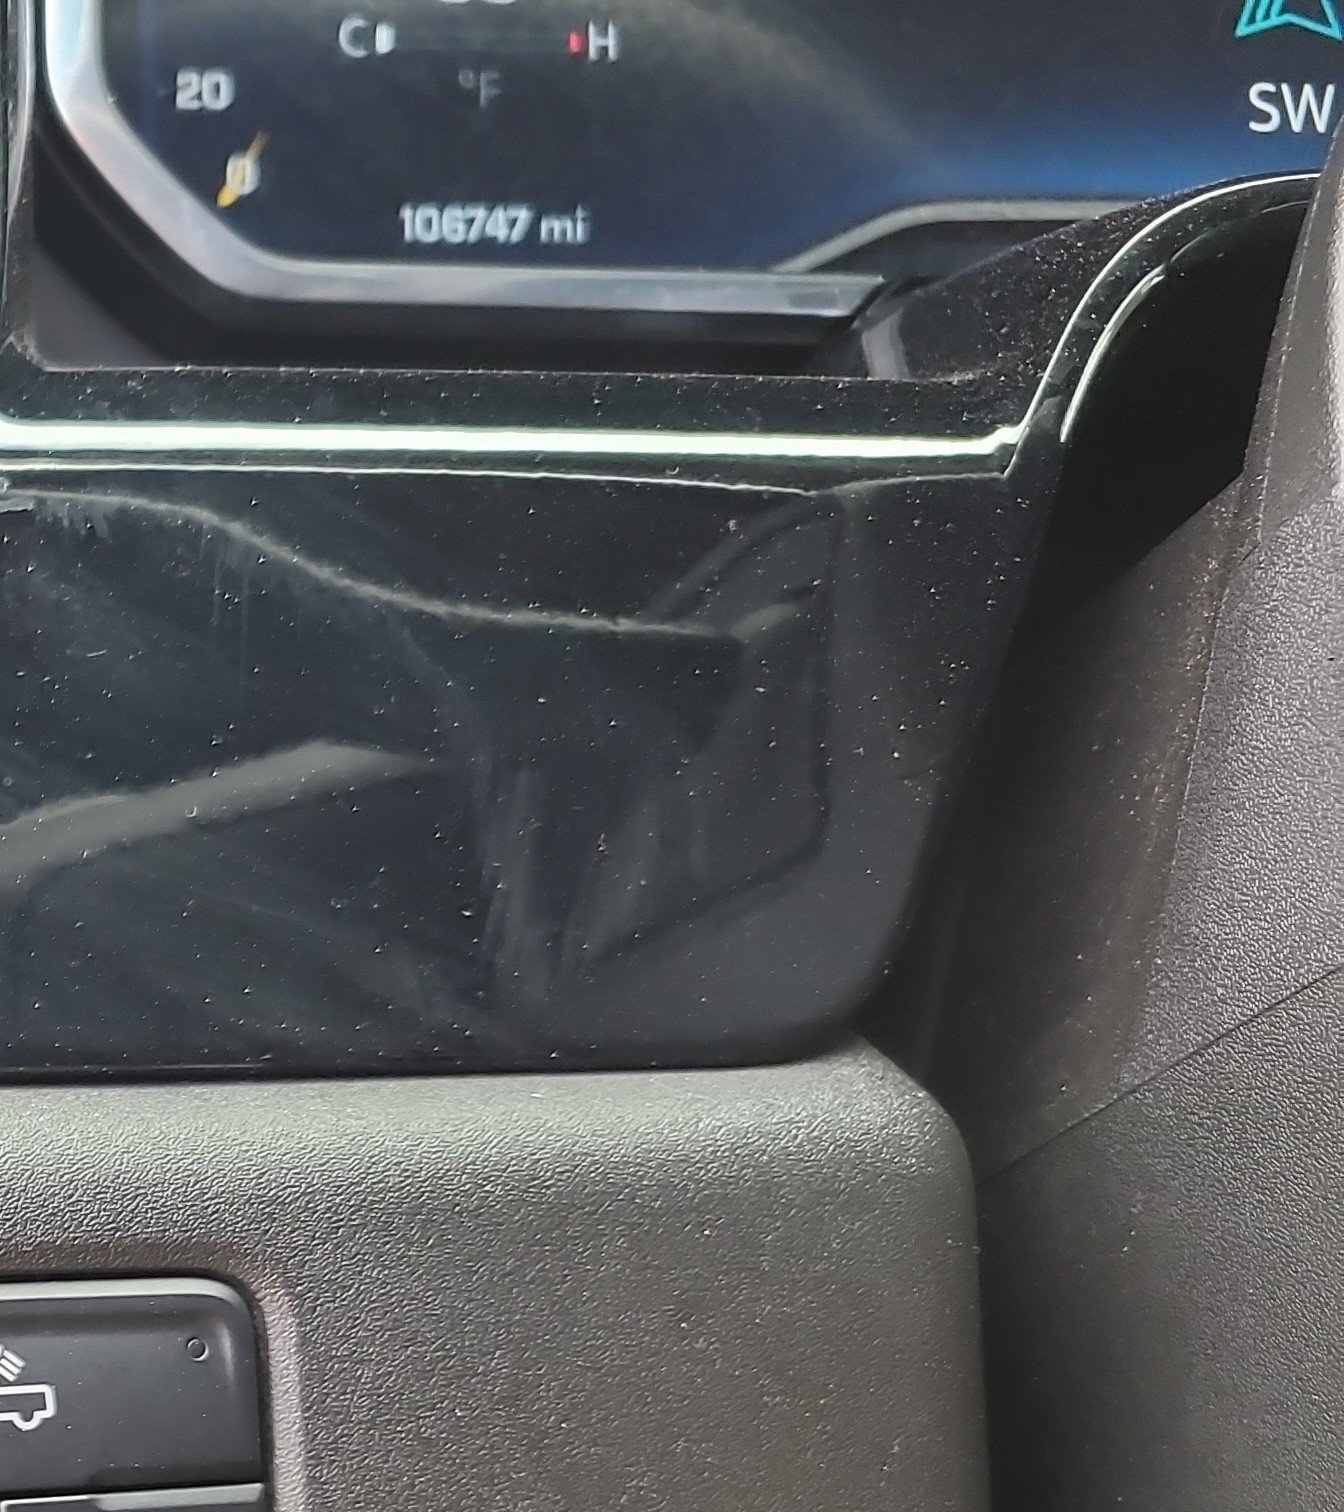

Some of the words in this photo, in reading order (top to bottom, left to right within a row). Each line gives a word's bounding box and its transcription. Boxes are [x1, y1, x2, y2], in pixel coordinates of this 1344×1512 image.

[587, 20, 619, 62] H
[175, 68, 234, 111] 20
[1248, 81, 1336, 134] SW
[398, 202, 532, 244] 106747
[539, 204, 590, 244] mi
